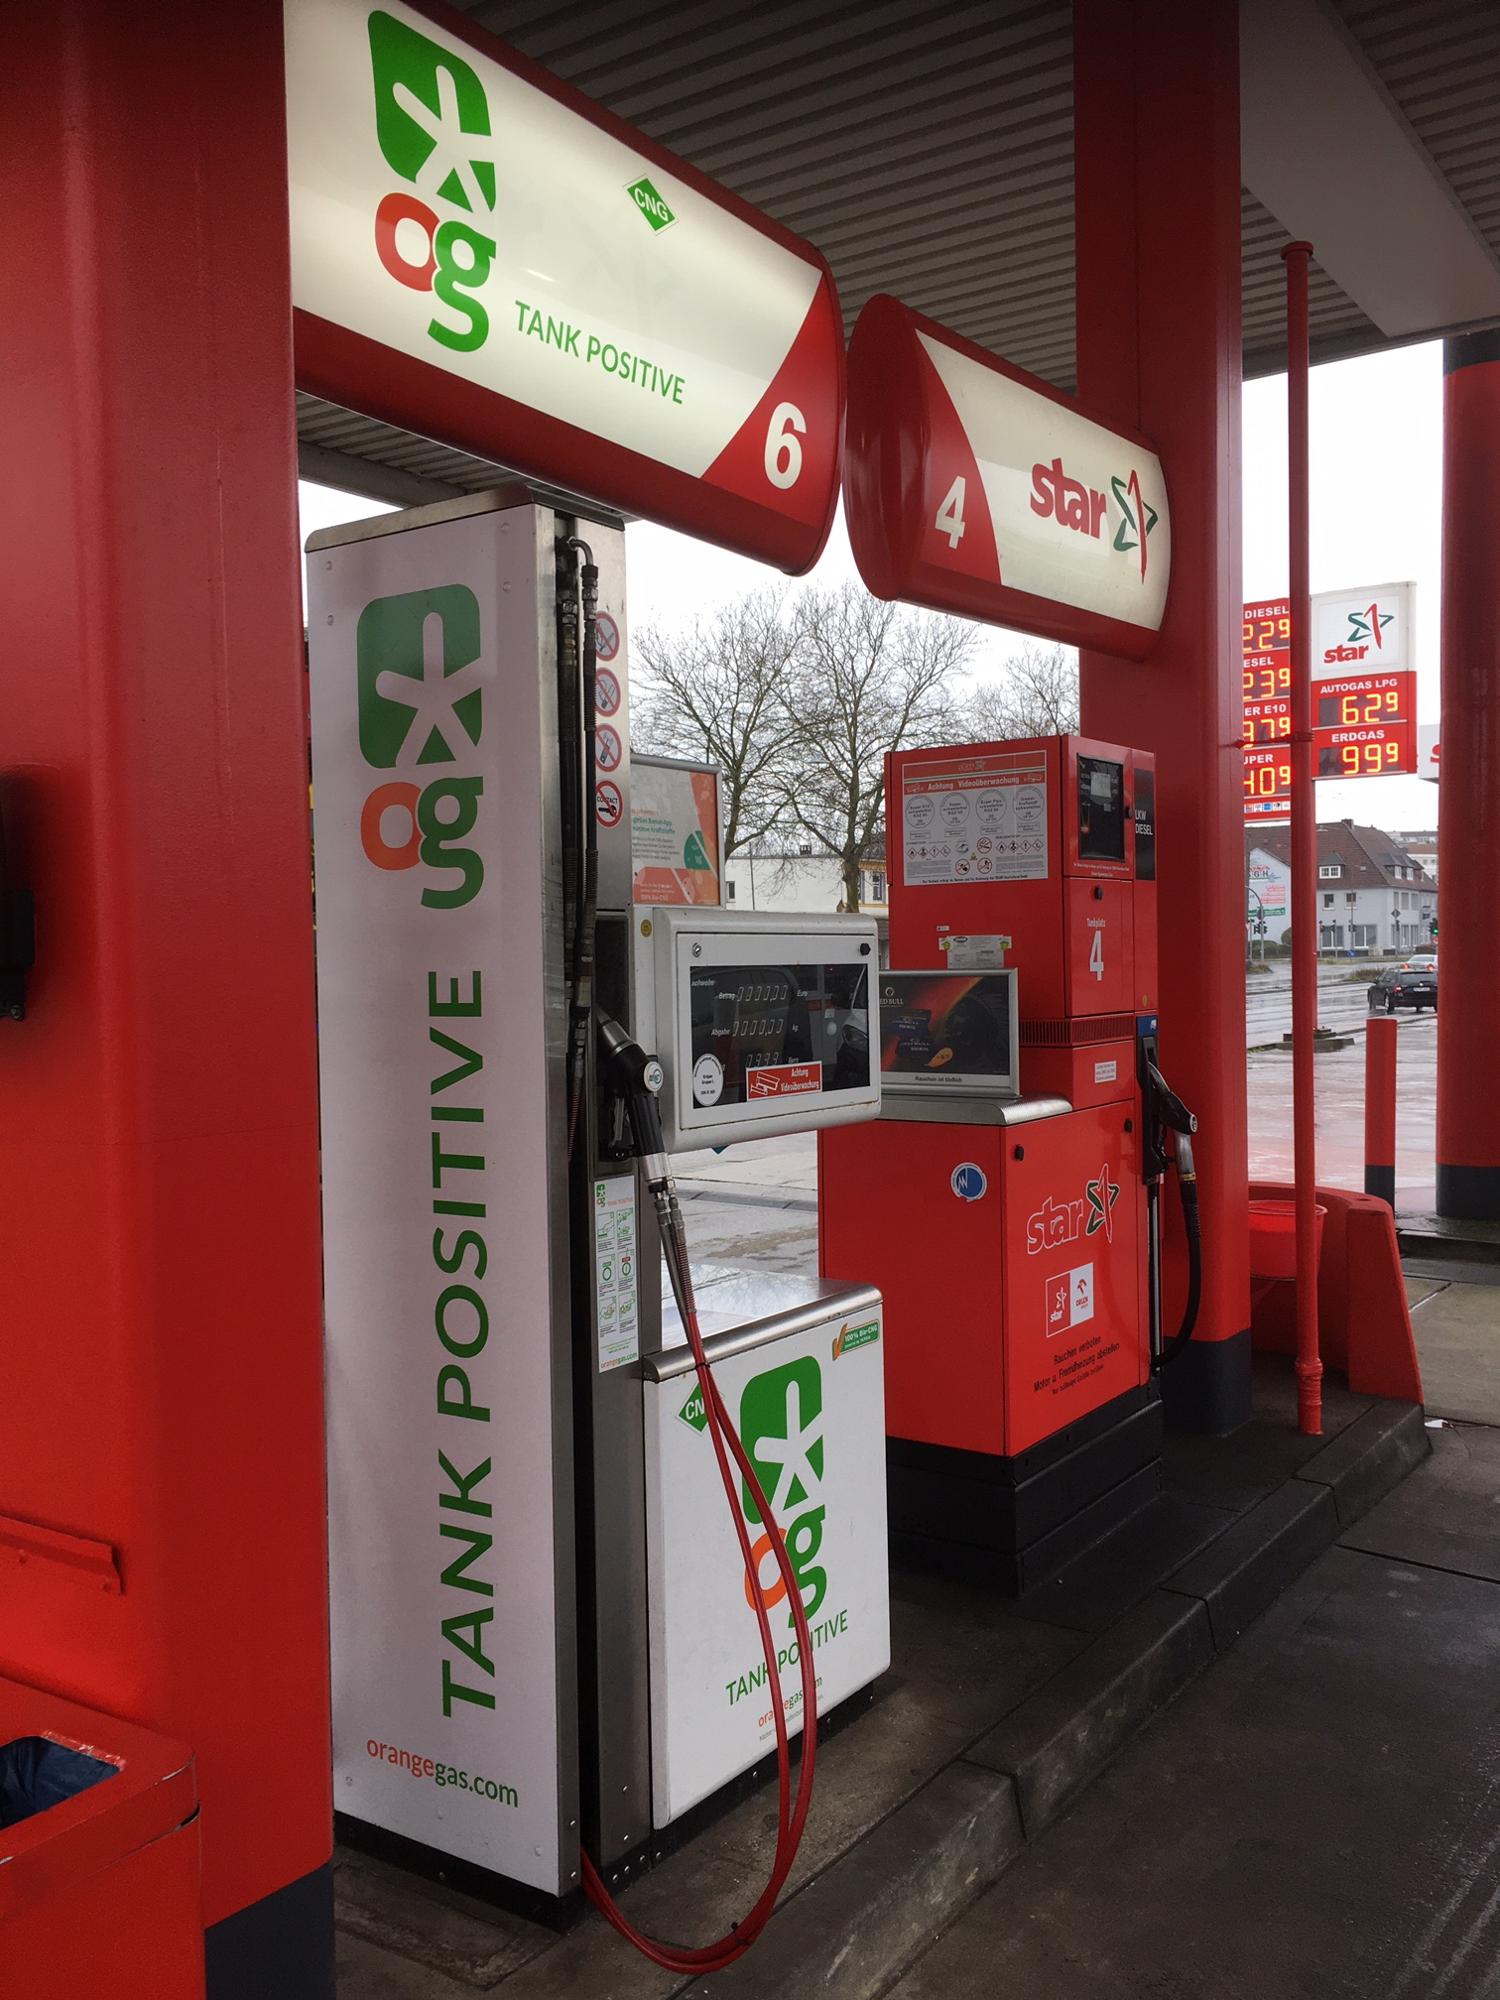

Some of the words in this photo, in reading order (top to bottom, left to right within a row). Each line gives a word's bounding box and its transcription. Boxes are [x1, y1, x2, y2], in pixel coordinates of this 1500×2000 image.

[634, 187, 669, 223] CNG
[514, 300, 580, 358] TANK
[587, 336, 686, 405] POSITIVE
[764, 401, 807, 490] 6
[935, 475, 966, 549] 4
[1031, 458, 1106, 539] star
[1244, 606, 1289, 619] DIESEL
[1323, 639, 1369, 663] star
[1264, 703, 1287, 714] E10
[1320, 680, 1372, 694] AUTOGAS
[1375, 678, 1398, 688] LPG
[1342, 691, 1399, 724] 629
[1331, 729, 1385, 743] ERDGAS
[1342, 742, 1399, 775] 999
[1135, 823, 1154, 835] DIESEL
[1089, 929, 1104, 981] 4
[428, 970, 491, 1422] POSITIVE
[1026, 1196, 1084, 1255] star
[437, 1448, 496, 1719] TANK
[777, 1608, 848, 1674] POITIVE
[366, 1739, 518, 1808] orangegas.com
